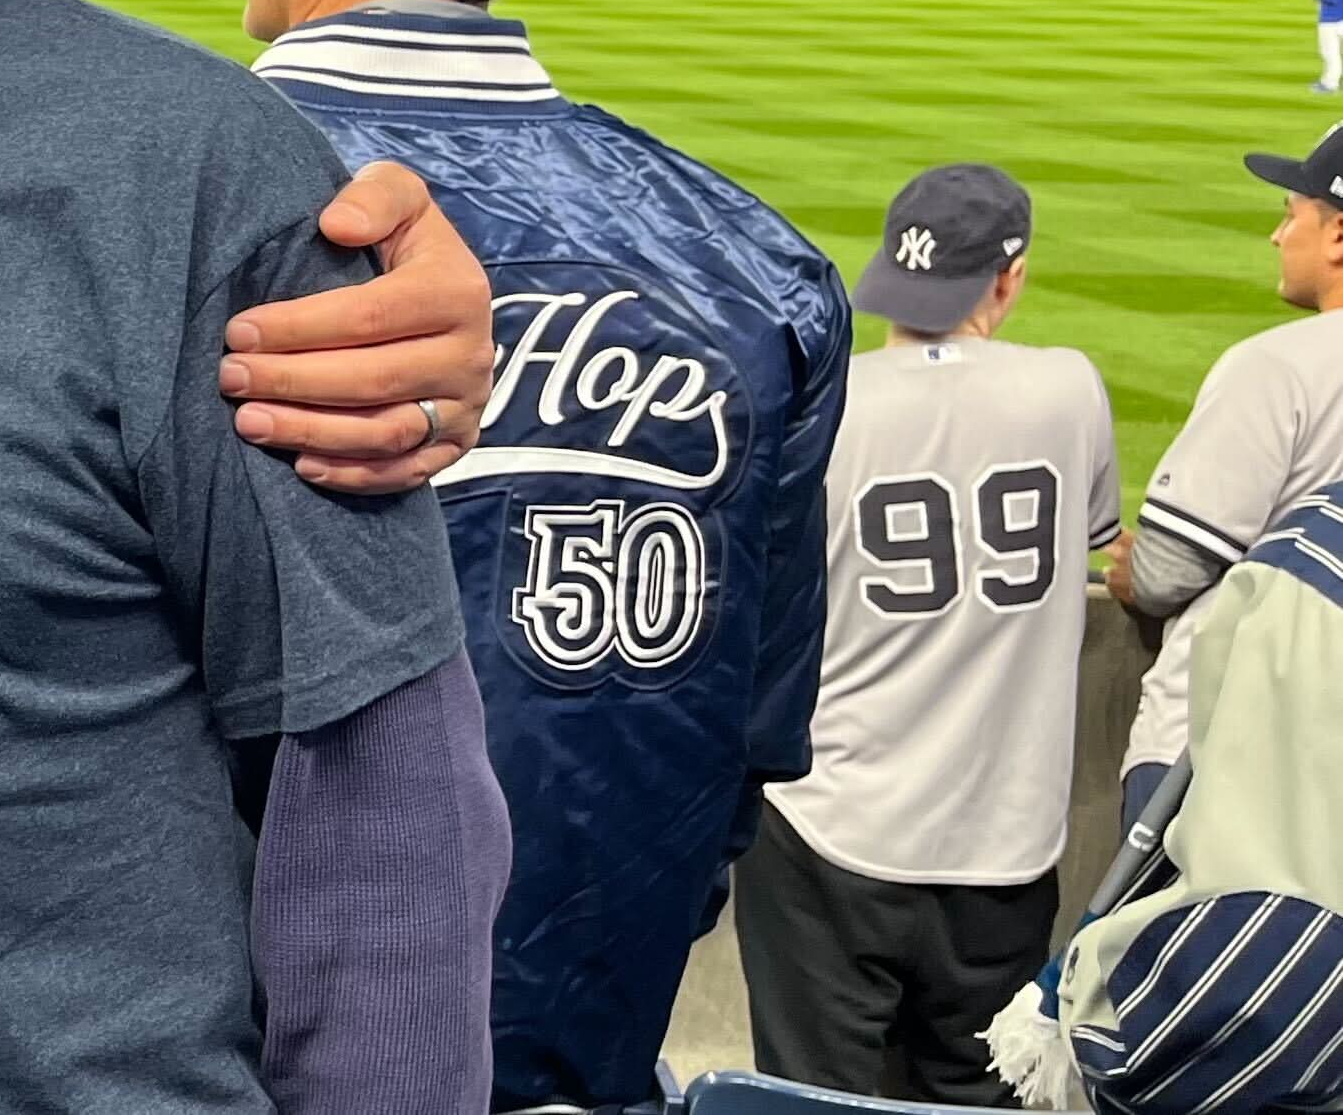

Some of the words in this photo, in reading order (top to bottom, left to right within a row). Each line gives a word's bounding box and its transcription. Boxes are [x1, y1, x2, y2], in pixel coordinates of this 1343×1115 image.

[896, 225, 937, 271] NY
[514, 499, 705, 671] 50
[854, 459, 1062, 620] 99
